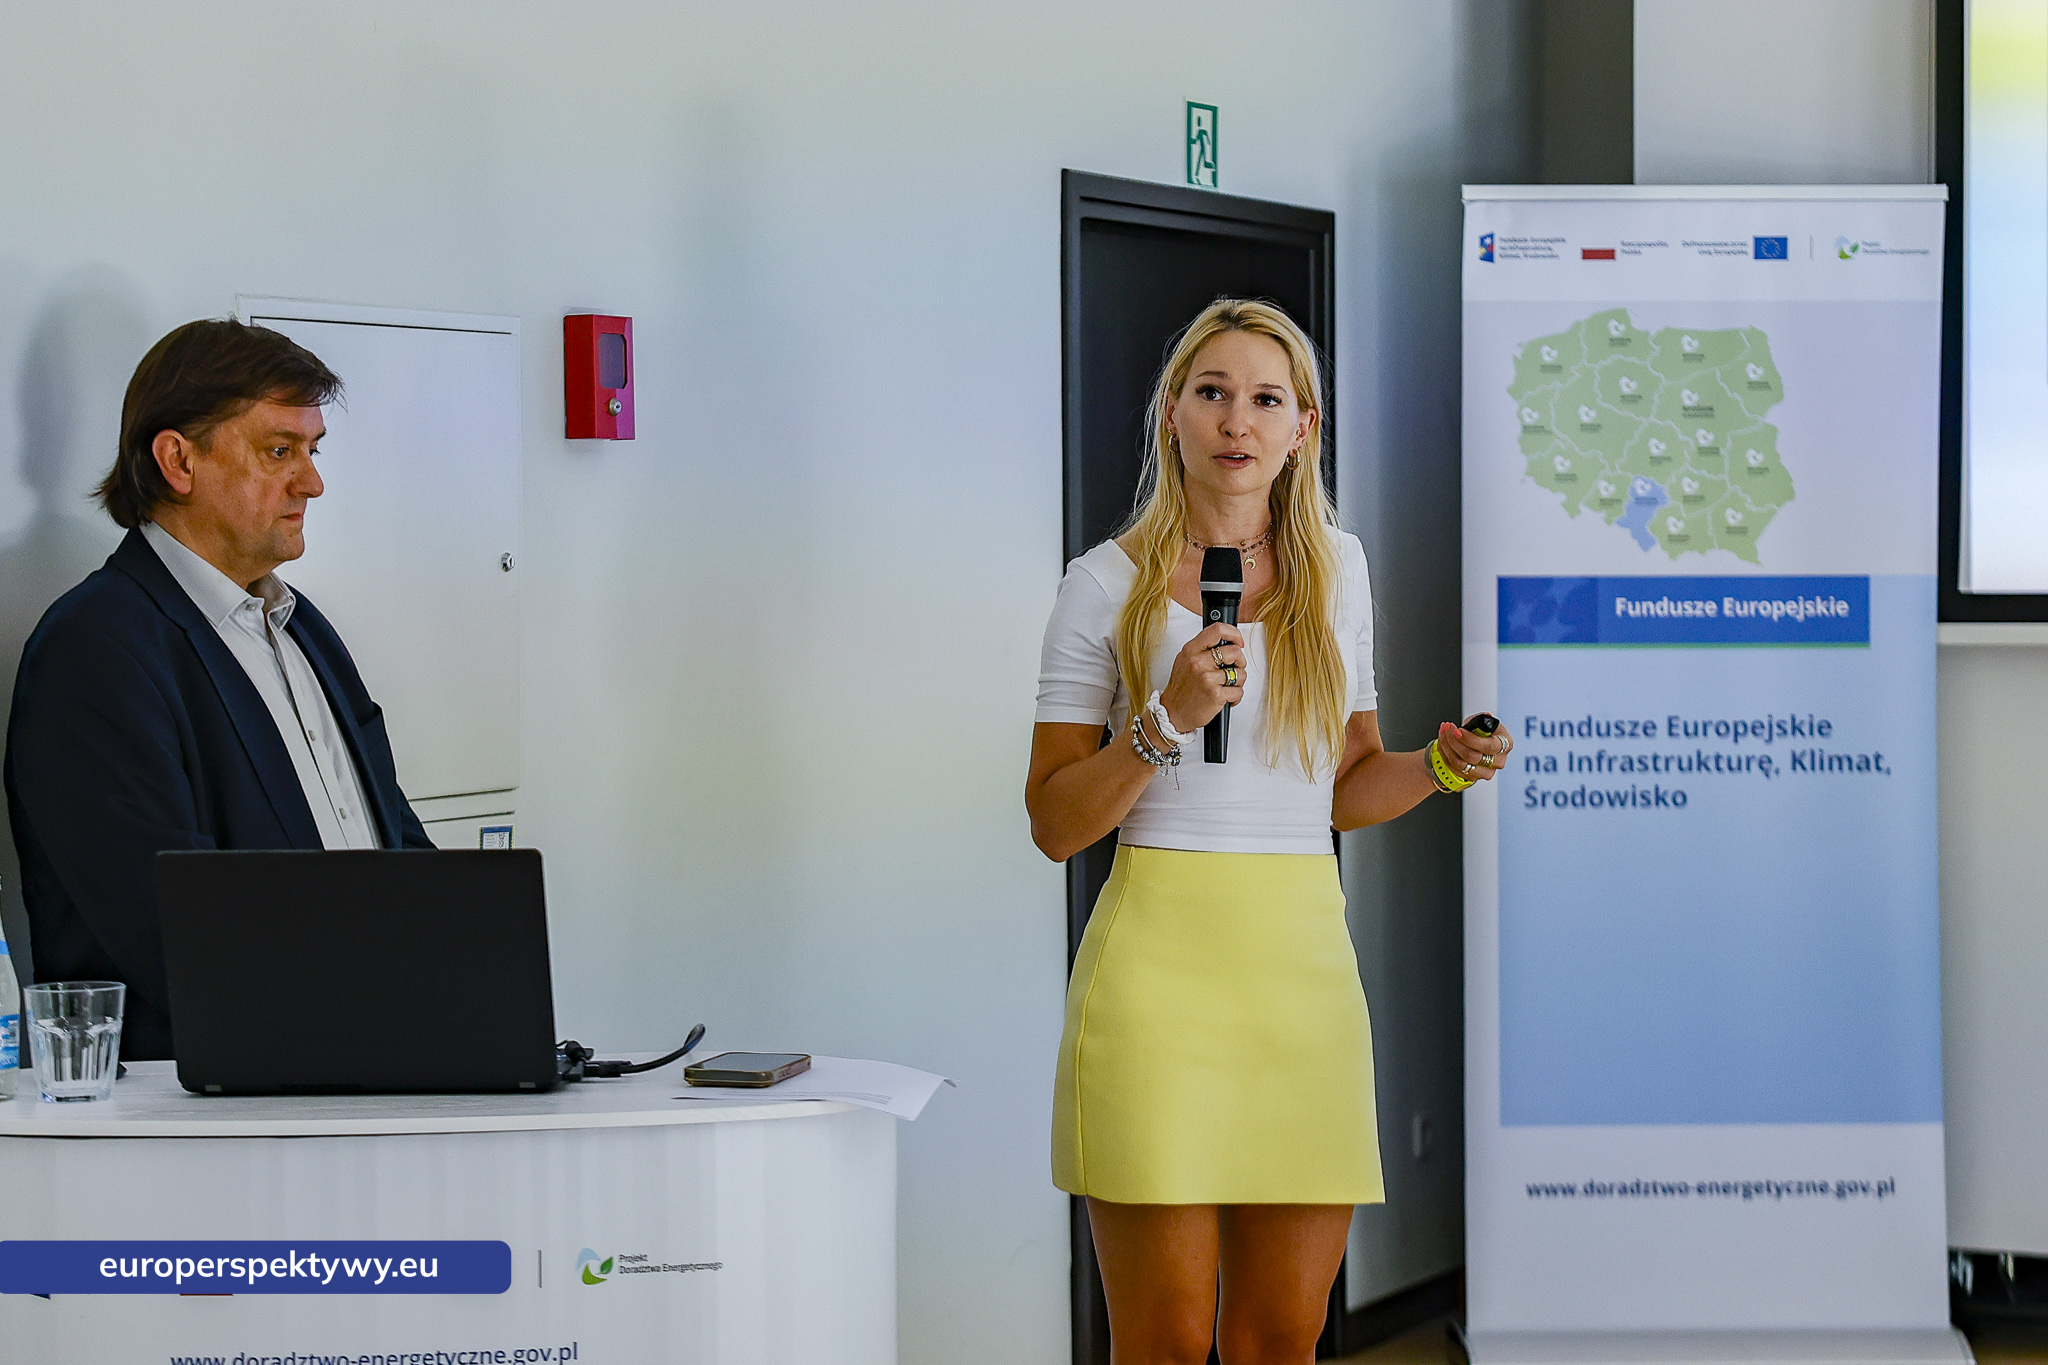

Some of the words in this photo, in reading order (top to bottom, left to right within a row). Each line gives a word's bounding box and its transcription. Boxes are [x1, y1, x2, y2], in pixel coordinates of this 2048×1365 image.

[1615, 596, 1718, 618] Fundusze
[1723, 596, 1850, 623] Europejskie
[1525, 715, 1658, 740] Fundusze
[1668, 713, 1834, 745] Europejskie
[1525, 755, 1558, 774] na
[1568, 750, 1781, 779] Infrastrukturę,
[1792, 749, 1892, 777] Klimat,
[1525, 780, 1689, 810] Środowisko
[619, 1254, 648, 1264] Projekt
[170, 1342, 578, 1365] wwwdoradztwo-energetyczne.gov.pl
